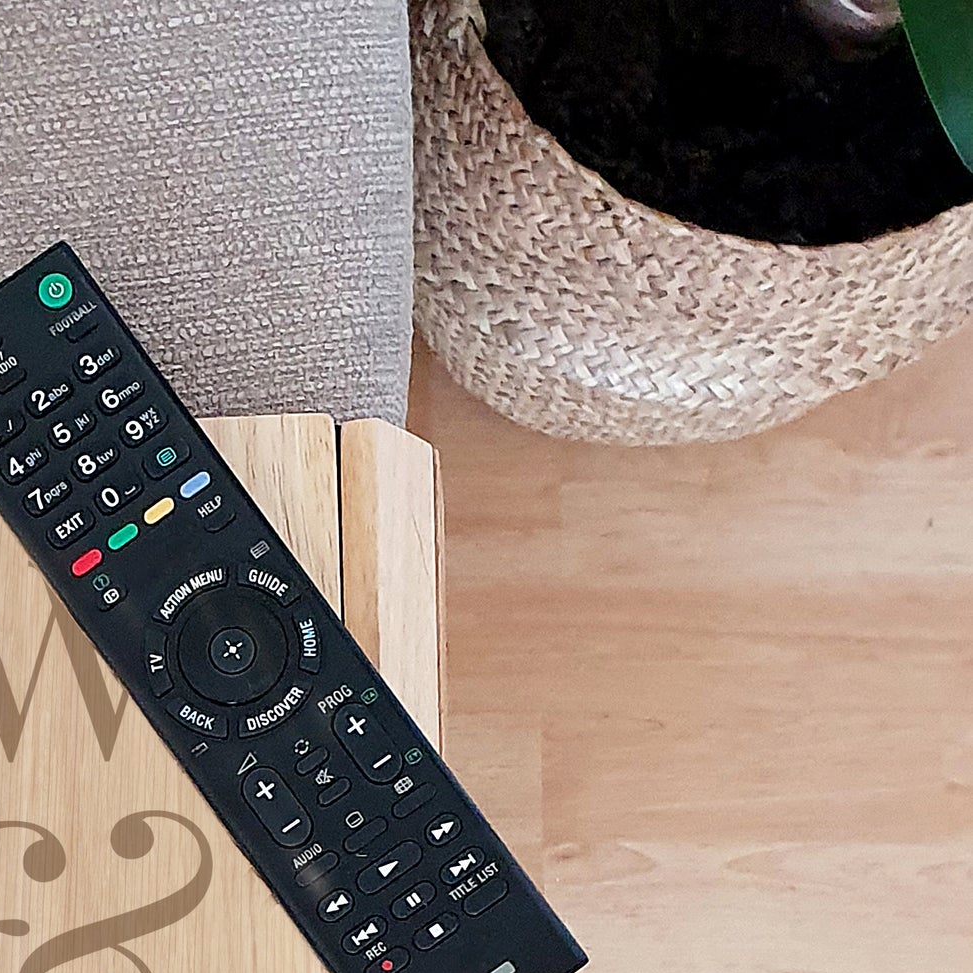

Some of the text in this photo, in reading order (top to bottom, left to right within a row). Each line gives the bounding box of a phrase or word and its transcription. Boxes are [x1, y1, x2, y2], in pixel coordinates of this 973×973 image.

[48, 300, 98, 337] FOOTBALL
[125, 420, 144, 441] 9
[101, 487, 120, 508] 0
[196, 494, 222, 519] HELP
[54, 512, 85, 540] EXIT
[159, 567, 224, 620] ACTION MENU
[247, 568, 289, 598] GUIDE
[299, 618, 317, 657] HOME
[149, 653, 164, 673] TV
[246, 686, 305, 731] DISCOVER
[316, 684, 354, 714] PROG
[179, 704, 216, 731] BACK
[292, 843, 323, 870] AUDIO
[448, 862, 499, 901] TITLE LIST
[364, 941, 387, 961] REC
